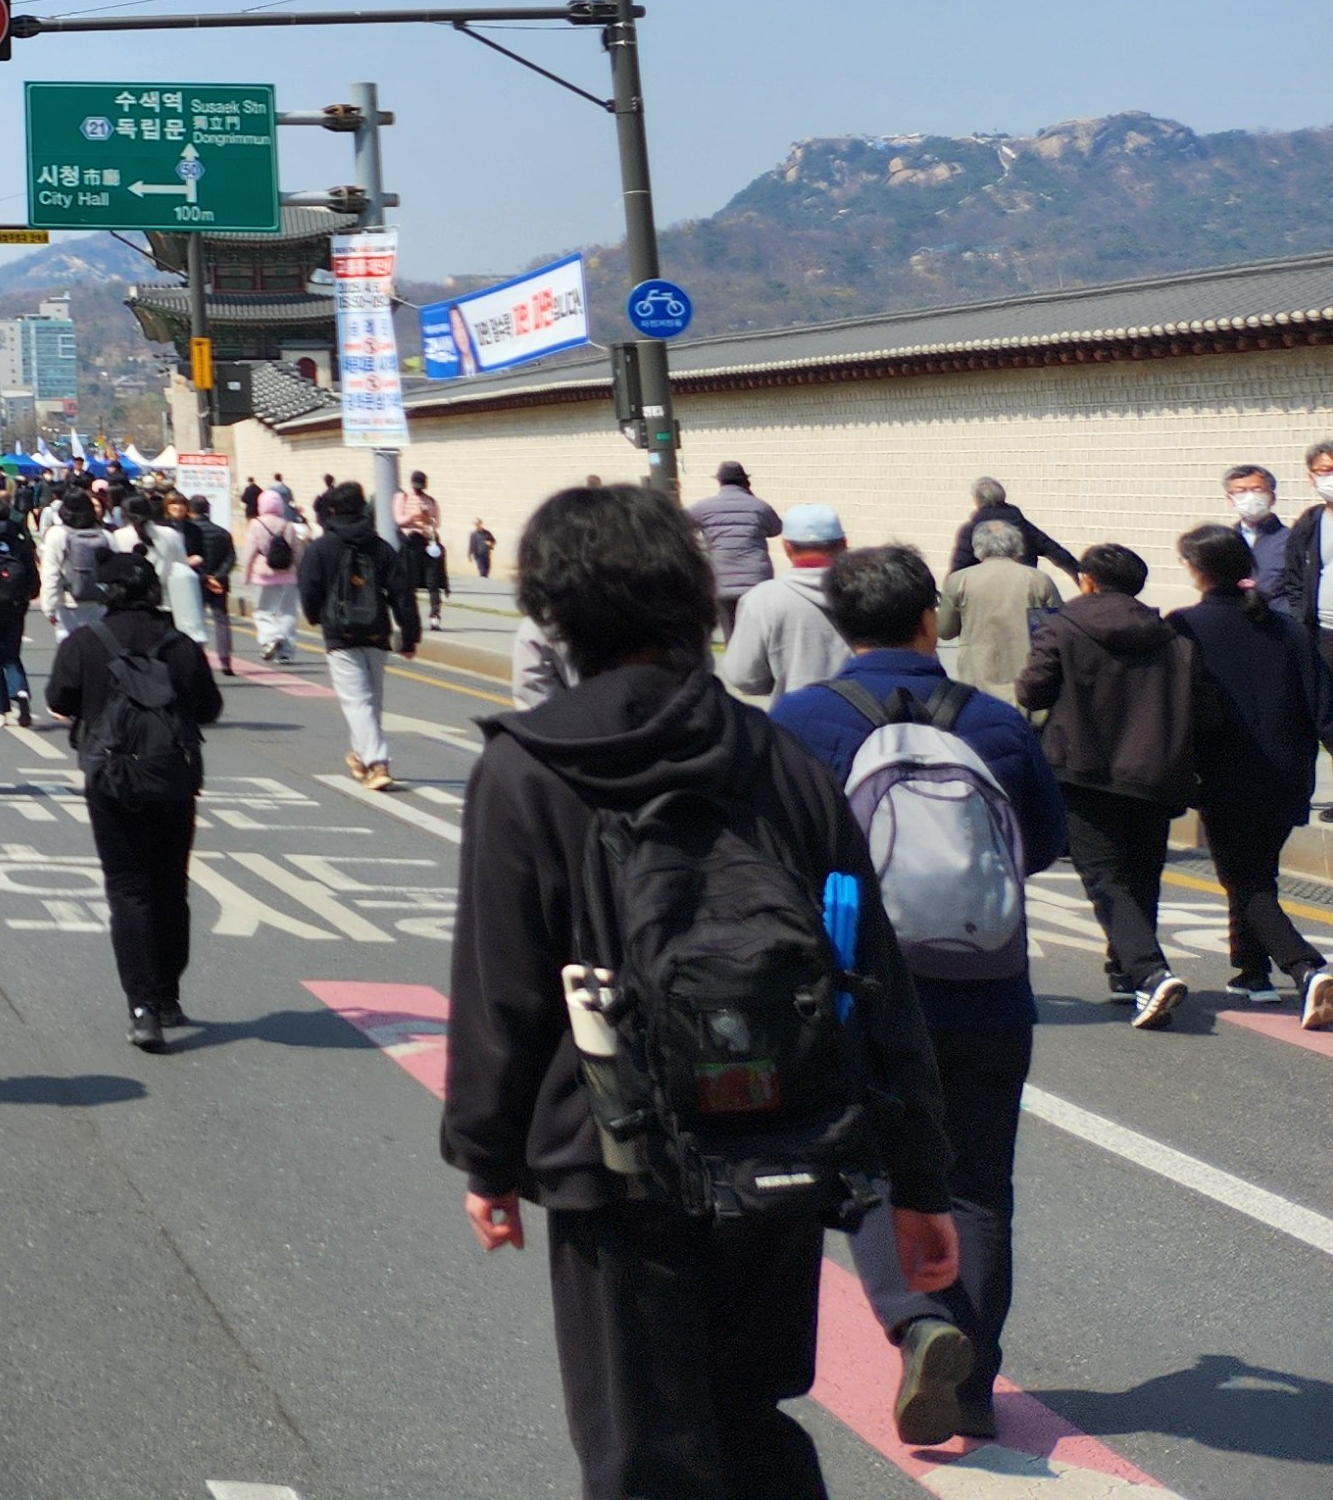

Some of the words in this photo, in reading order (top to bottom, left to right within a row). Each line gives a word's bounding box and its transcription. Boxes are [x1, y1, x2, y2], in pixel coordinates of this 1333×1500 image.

[114, 91, 183, 113] 수색역
[190, 99, 240, 114] Susaek
[242, 99, 267, 114] Stn
[89, 122, 106, 136] 21
[115, 118, 186, 141] 독립문
[192, 132, 271, 147] Dongnimmun
[36, 165, 80, 187] 시청
[38, 191, 73, 208] City
[77, 192, 110, 206] Hall
[173, 206, 215, 222] 100m
